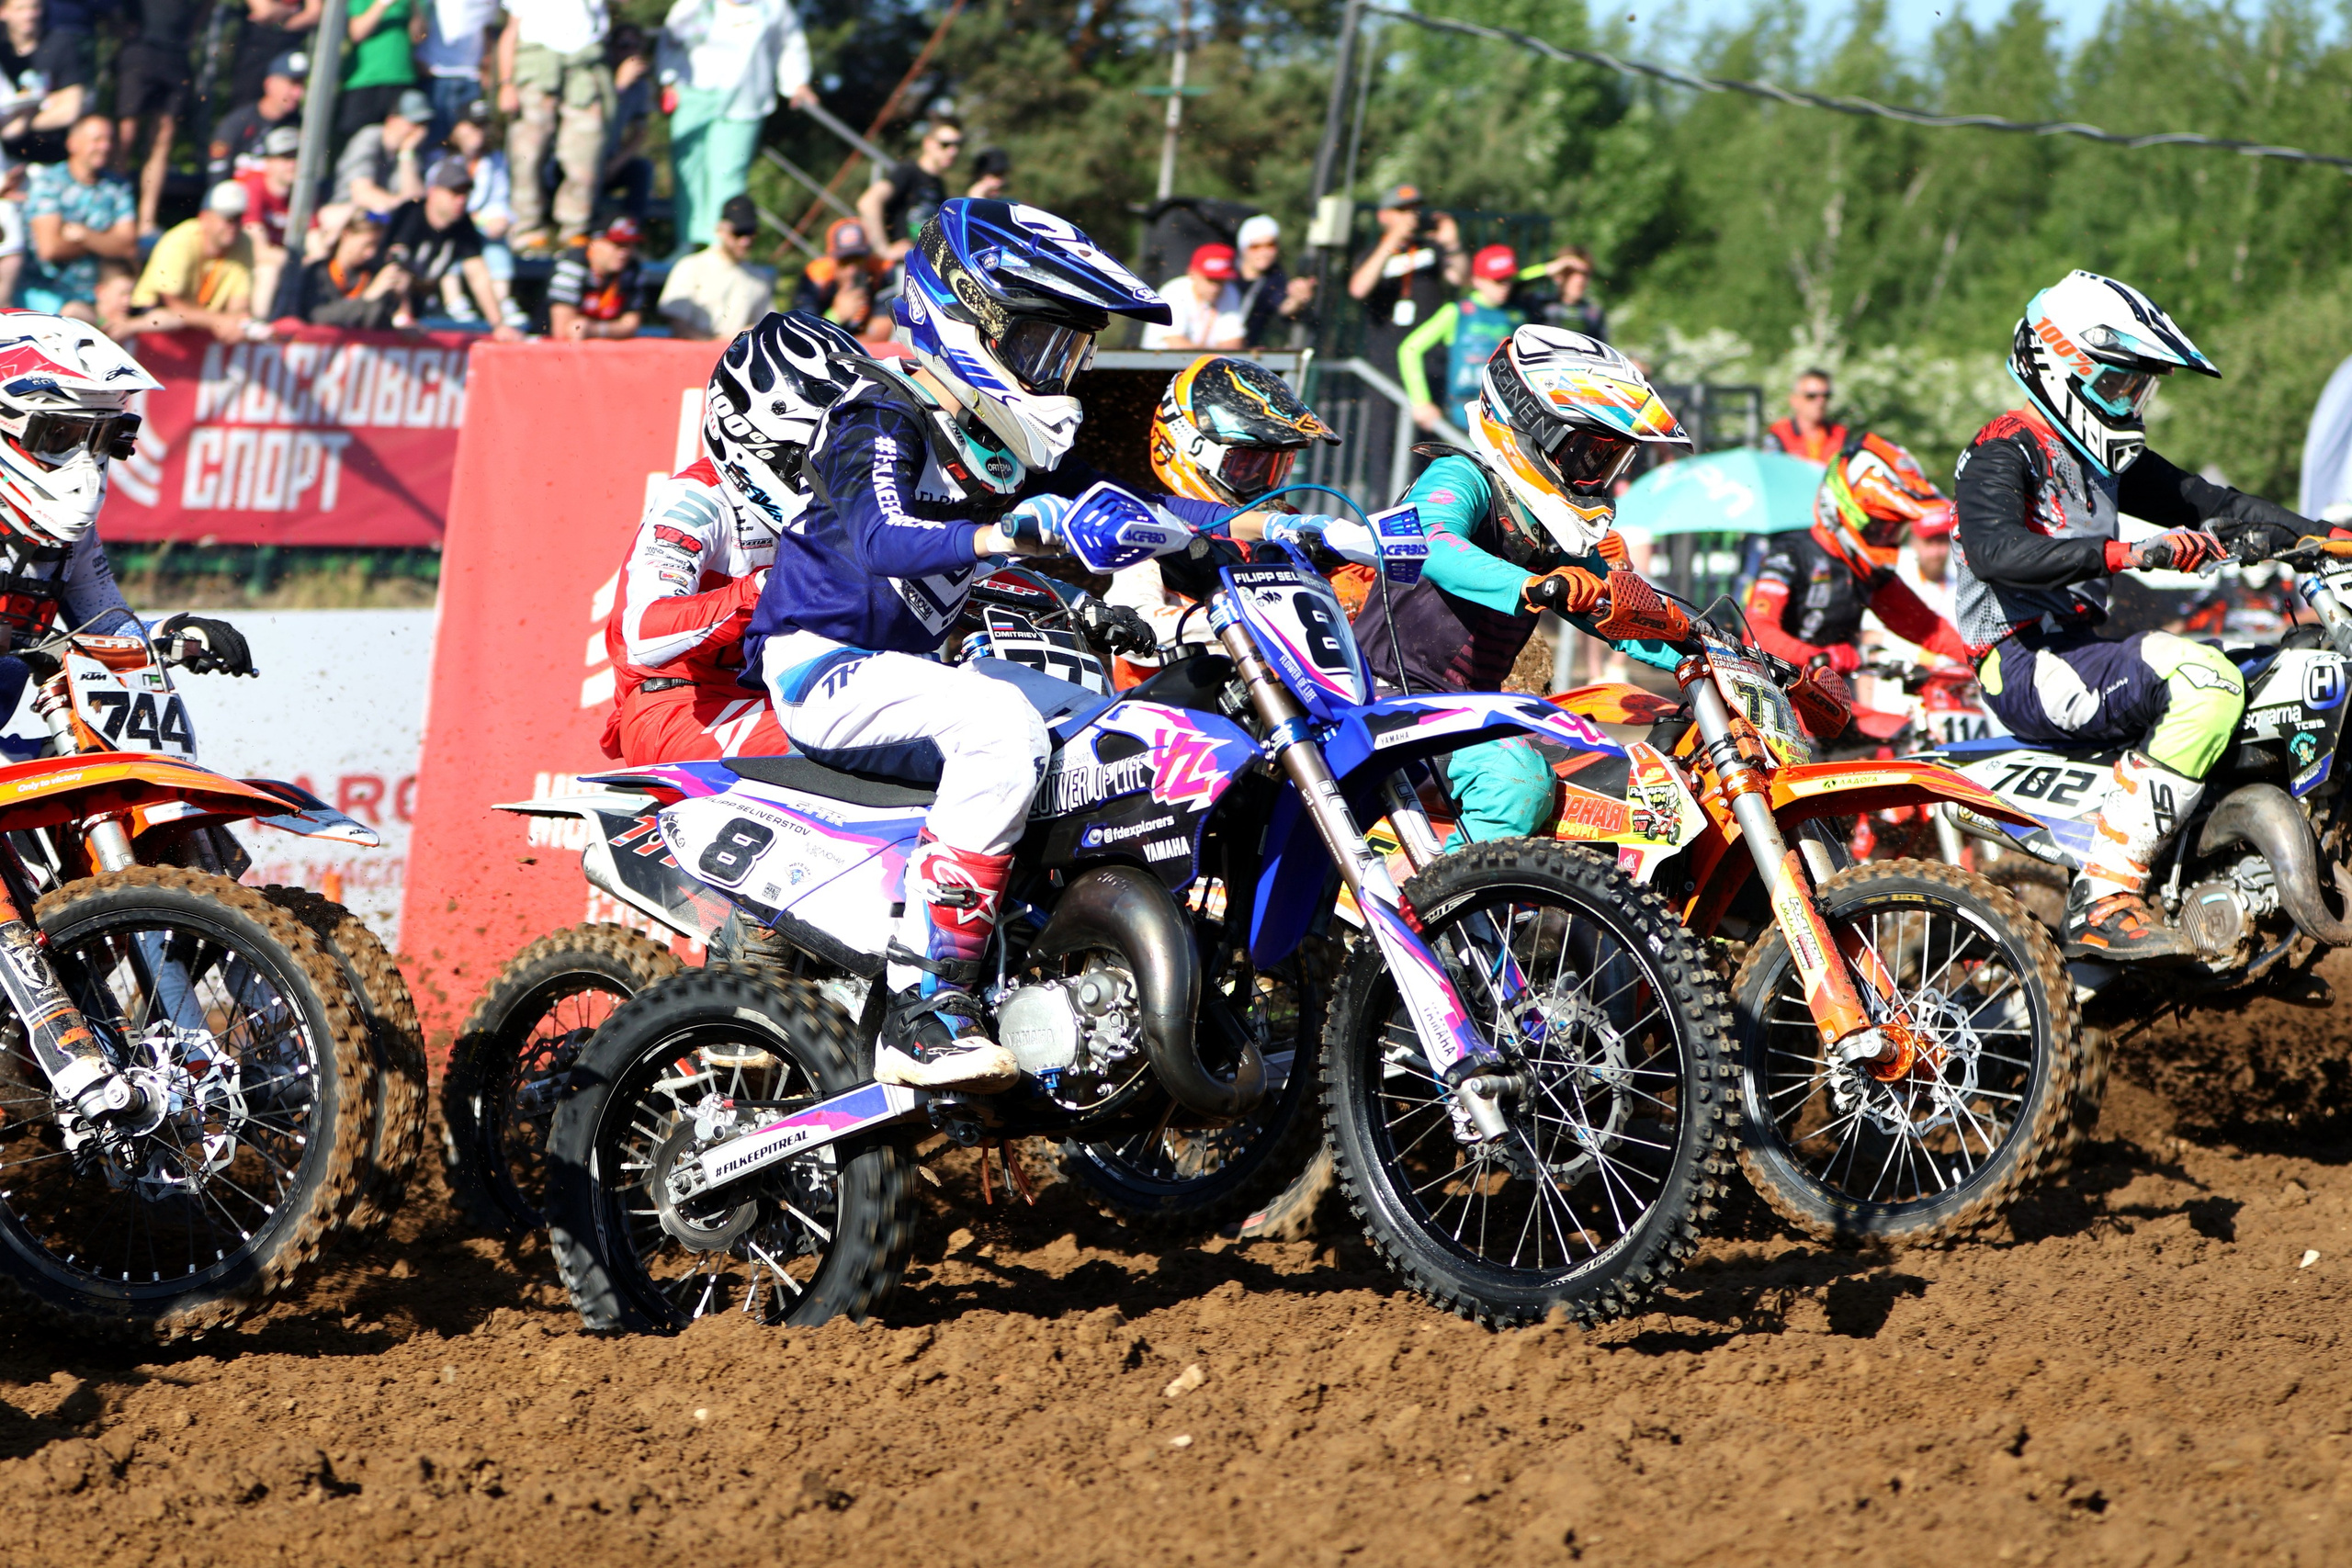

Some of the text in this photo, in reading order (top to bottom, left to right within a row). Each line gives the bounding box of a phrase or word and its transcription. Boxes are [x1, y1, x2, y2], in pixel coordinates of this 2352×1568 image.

[2033, 316, 2095, 376] 100%
[709, 379, 780, 459] 100%
[182, 429, 352, 512] СПОРТ
[987, 462, 1012, 474] ORTEMA
[1122, 529, 1167, 544] ACERBIS
[1374, 544, 1428, 557] ACERBIS
[1234, 572, 1274, 583] FILIPP
[74, 636, 140, 649] SCAR
[994, 630, 1037, 639] DMITRIEV
[1292, 592, 1356, 669] 8
[80, 671, 107, 681] KTM
[1279, 654, 1302, 681] FLOWER
[1297, 677, 1308, 688] OF
[1303, 685, 1317, 702] LIFE
[1806, 691, 1841, 718] ACERBIS
[87, 692, 193, 754] 744
[1944, 717, 1991, 742] 114
[1380, 731, 1409, 745] YAMAHA
[17, 772, 83, 793] Only to victory
[1114, 755, 1146, 795] LIFE
[1991, 763, 2098, 807] 782
[703, 796, 810, 836] FILIPP SELIVERSTOV
[1562, 794, 1629, 832] РНАЯ
[1103, 816, 1174, 843] @fdexplorers
[698, 817, 775, 884] 8
[1142, 837, 1191, 863] YAMAHA
[1007, 1028, 1055, 1047] YAMAHA
[716, 1130, 809, 1178] #FILKEEPITREAL
